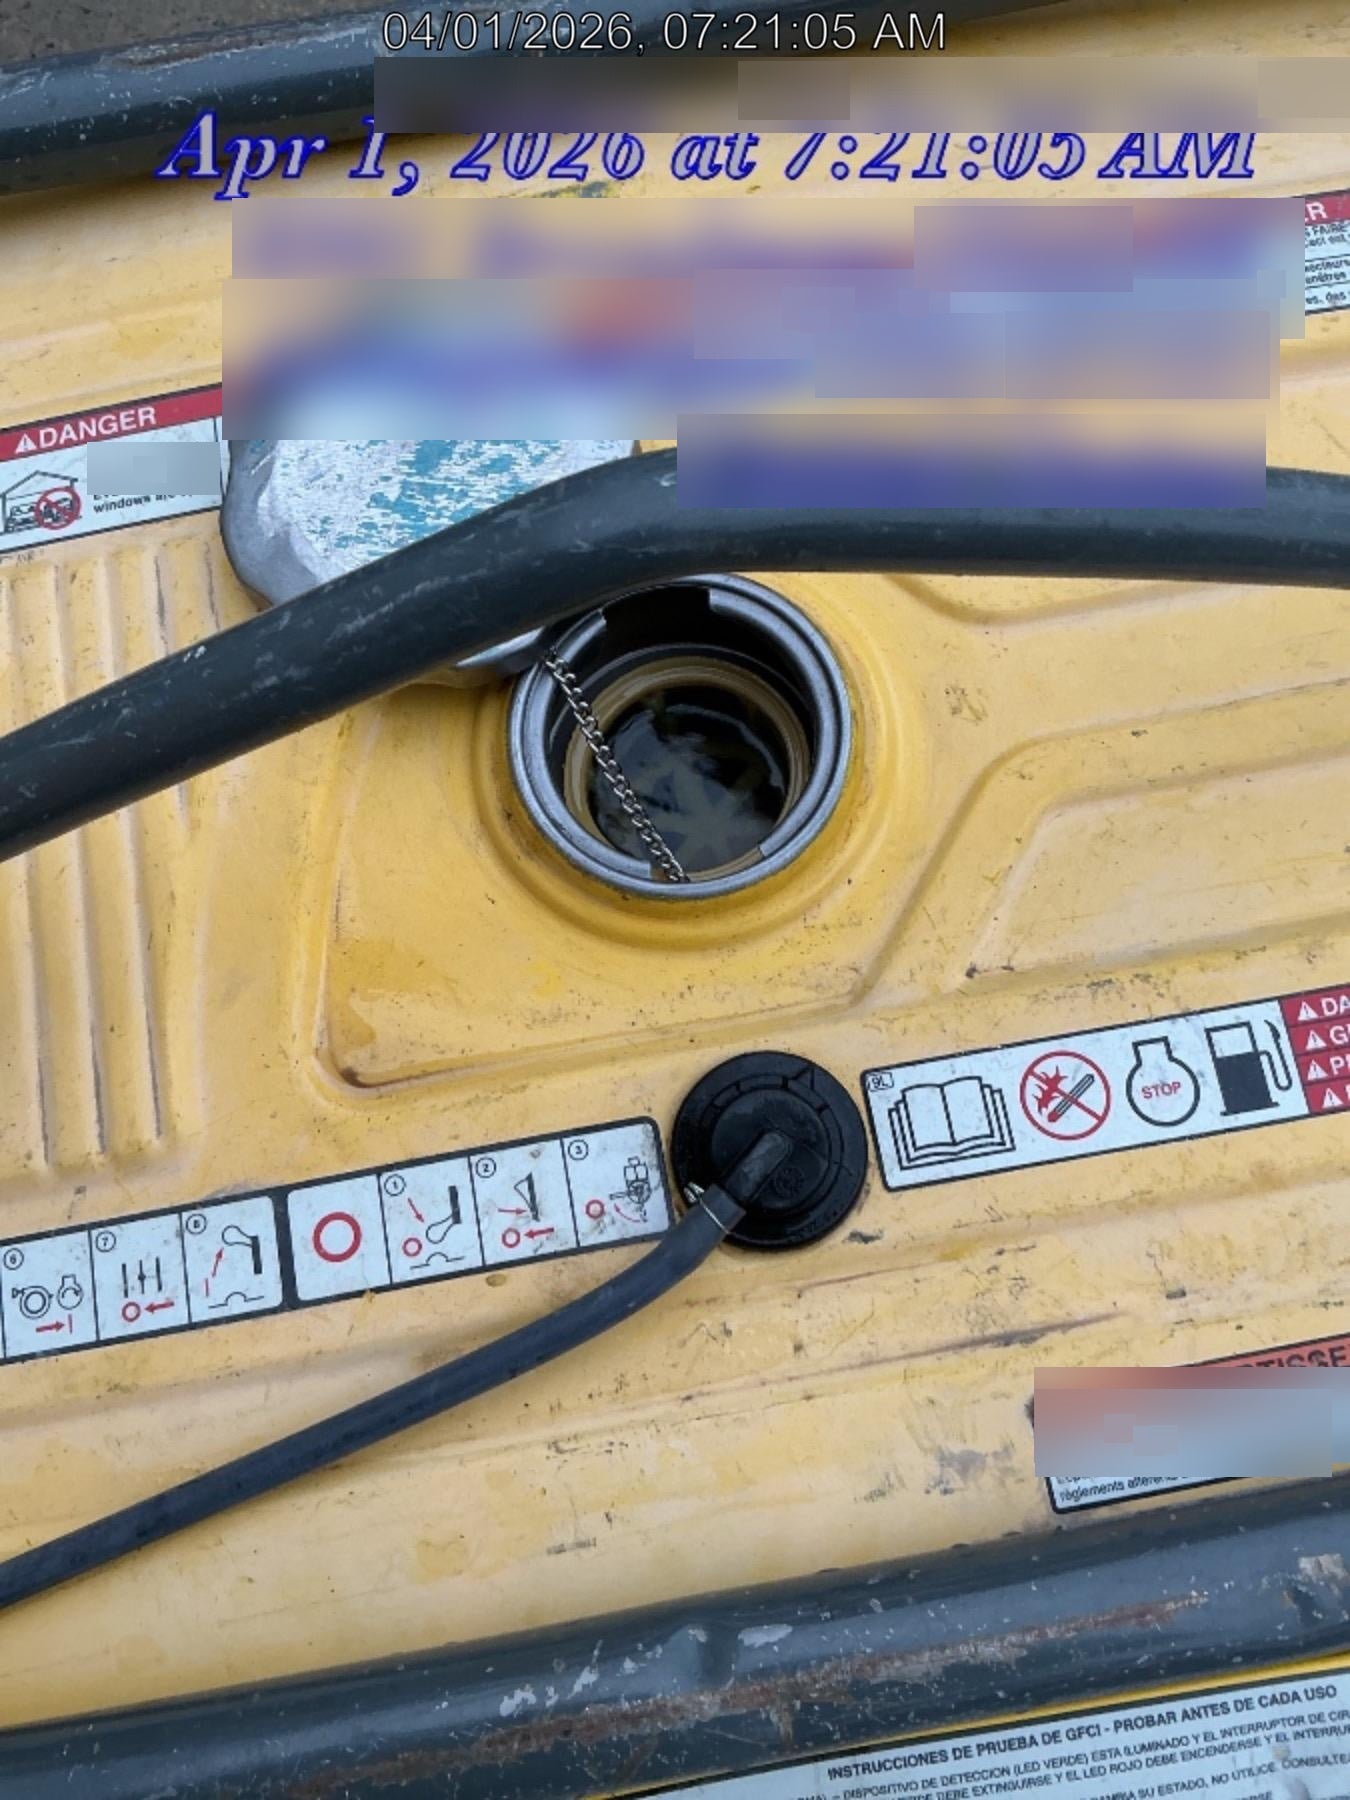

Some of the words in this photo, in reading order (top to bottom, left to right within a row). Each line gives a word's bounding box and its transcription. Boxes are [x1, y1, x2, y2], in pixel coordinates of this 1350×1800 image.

[39, 406, 157, 449] DANGER
[94, 495, 152, 514] windows
[1142, 1081, 1182, 1100] STOP
[828, 1750, 949, 1781] INSTRUCCIONES
[952, 1745, 974, 1760] DE
[976, 1736, 1039, 1757] PRUEBA
[1041, 1729, 1063, 1745] DE
[1065, 1724, 1102, 1741] GFCI
[1113, 1711, 1177, 1733] PROBAR
[1181, 1701, 1231, 1722] ANTES
[1233, 1697, 1255, 1713] DE
[1258, 1691, 1303, 1708] CADA
[1304, 1684, 1337, 1700] USO
[843, 1780, 919, 1800] DISPOSITIVO
[921, 1777, 938, 1790] DE
[941, 1764, 1011, 1787] DETECCION
[1014, 1760, 1041, 1777] (LED
[1044, 1753, 1089, 1769] VERDE)
[1091, 1747, 1123, 1763] ESTA
[1192, 1733, 1201, 1745] Y
[1203, 1730, 1219, 1742] EL
[1220, 1715, 1306, 1740] INTERRUPTOR
[1307, 1710, 1326, 1725] DE
[972, 1773, 1053, 1797] EXTINGUIRSE
[1054, 1772, 1063, 1783] Y
[1065, 1769, 1082, 1782] EL
[1083, 1764, 1107, 1779] LED
[1109, 1760, 1143, 1775] ROJO
[1145, 1752, 1178, 1768] DEBE
[1181, 1738, 1263, 1762] ENCENDERSE
[1264, 1733, 1273, 1745] Y
[1275, 1731, 1290, 1743] EL
[1157, 1777, 1209, 1797] ESTADO,
[1210, 1772, 1229, 1785] NO
